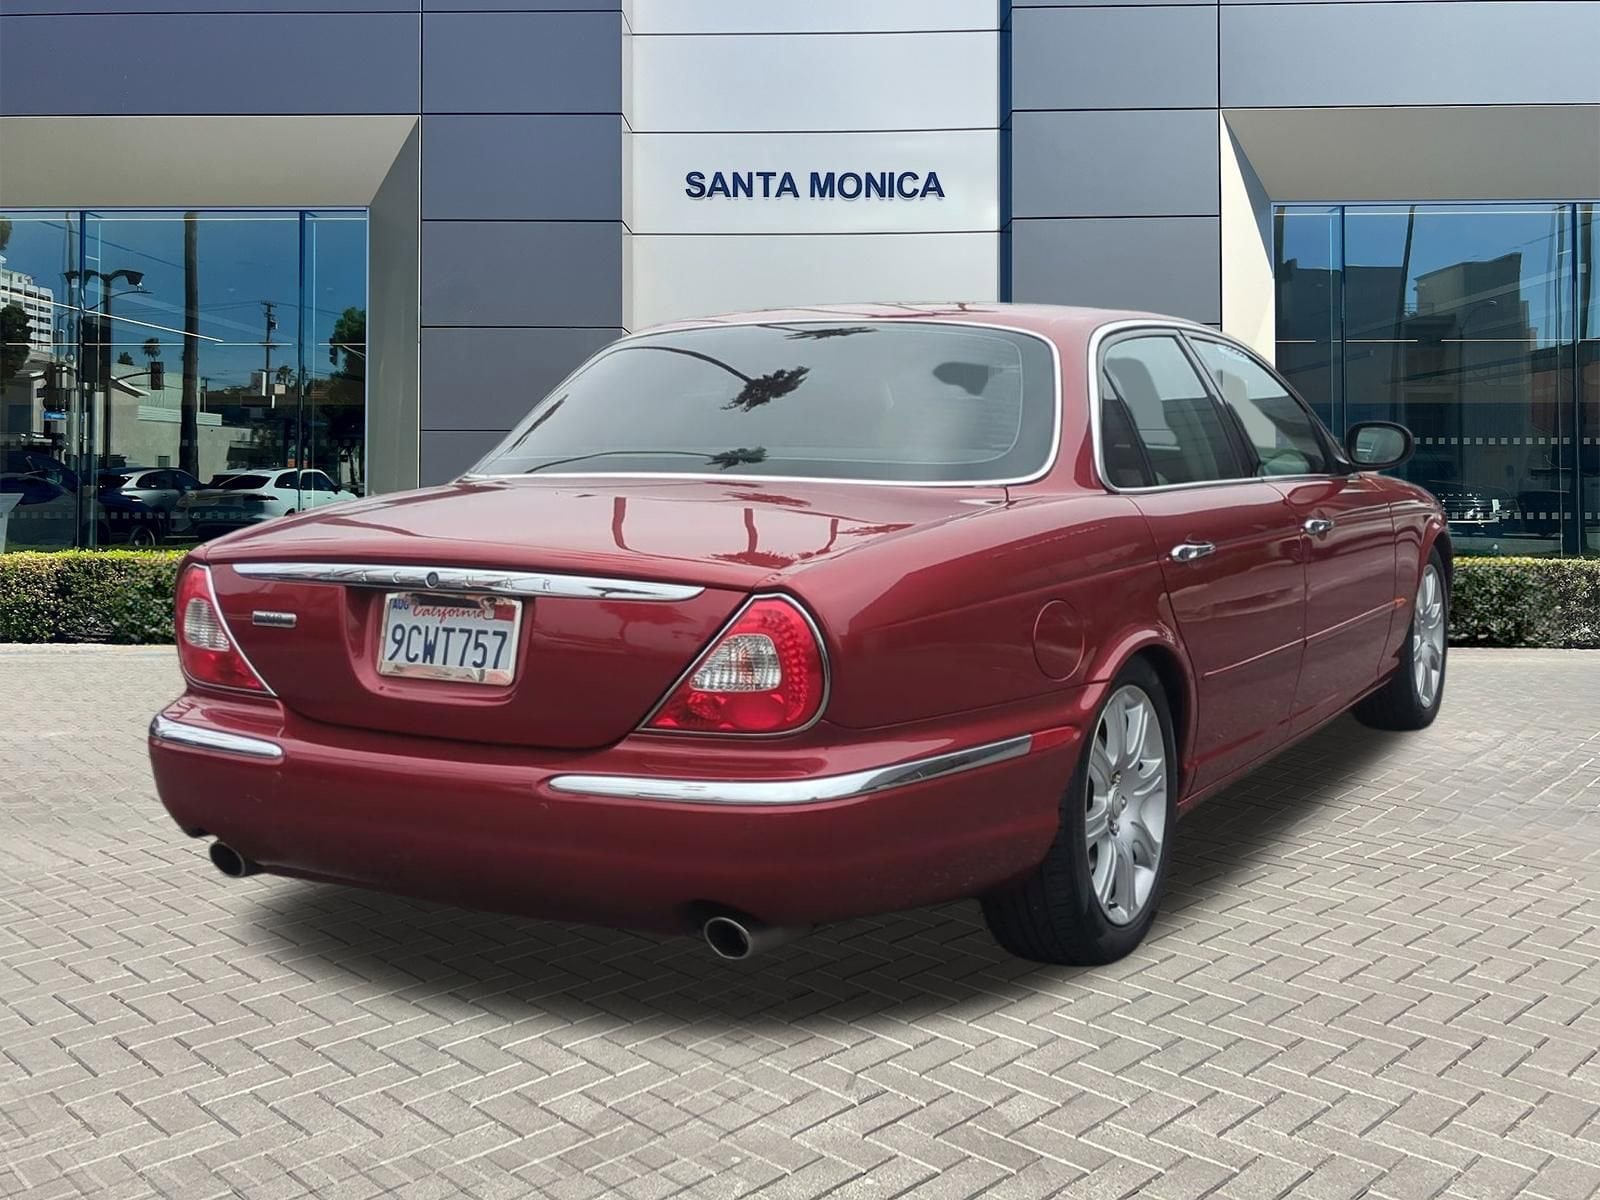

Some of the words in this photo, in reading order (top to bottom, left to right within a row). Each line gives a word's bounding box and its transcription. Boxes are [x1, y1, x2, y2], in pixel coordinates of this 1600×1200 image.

[685, 171, 800, 200] SANTA
[809, 171, 946, 200] MONICA
[391, 598, 410, 611] AUG
[412, 604, 486, 624] California
[387, 623, 508, 670] 9CWT757
